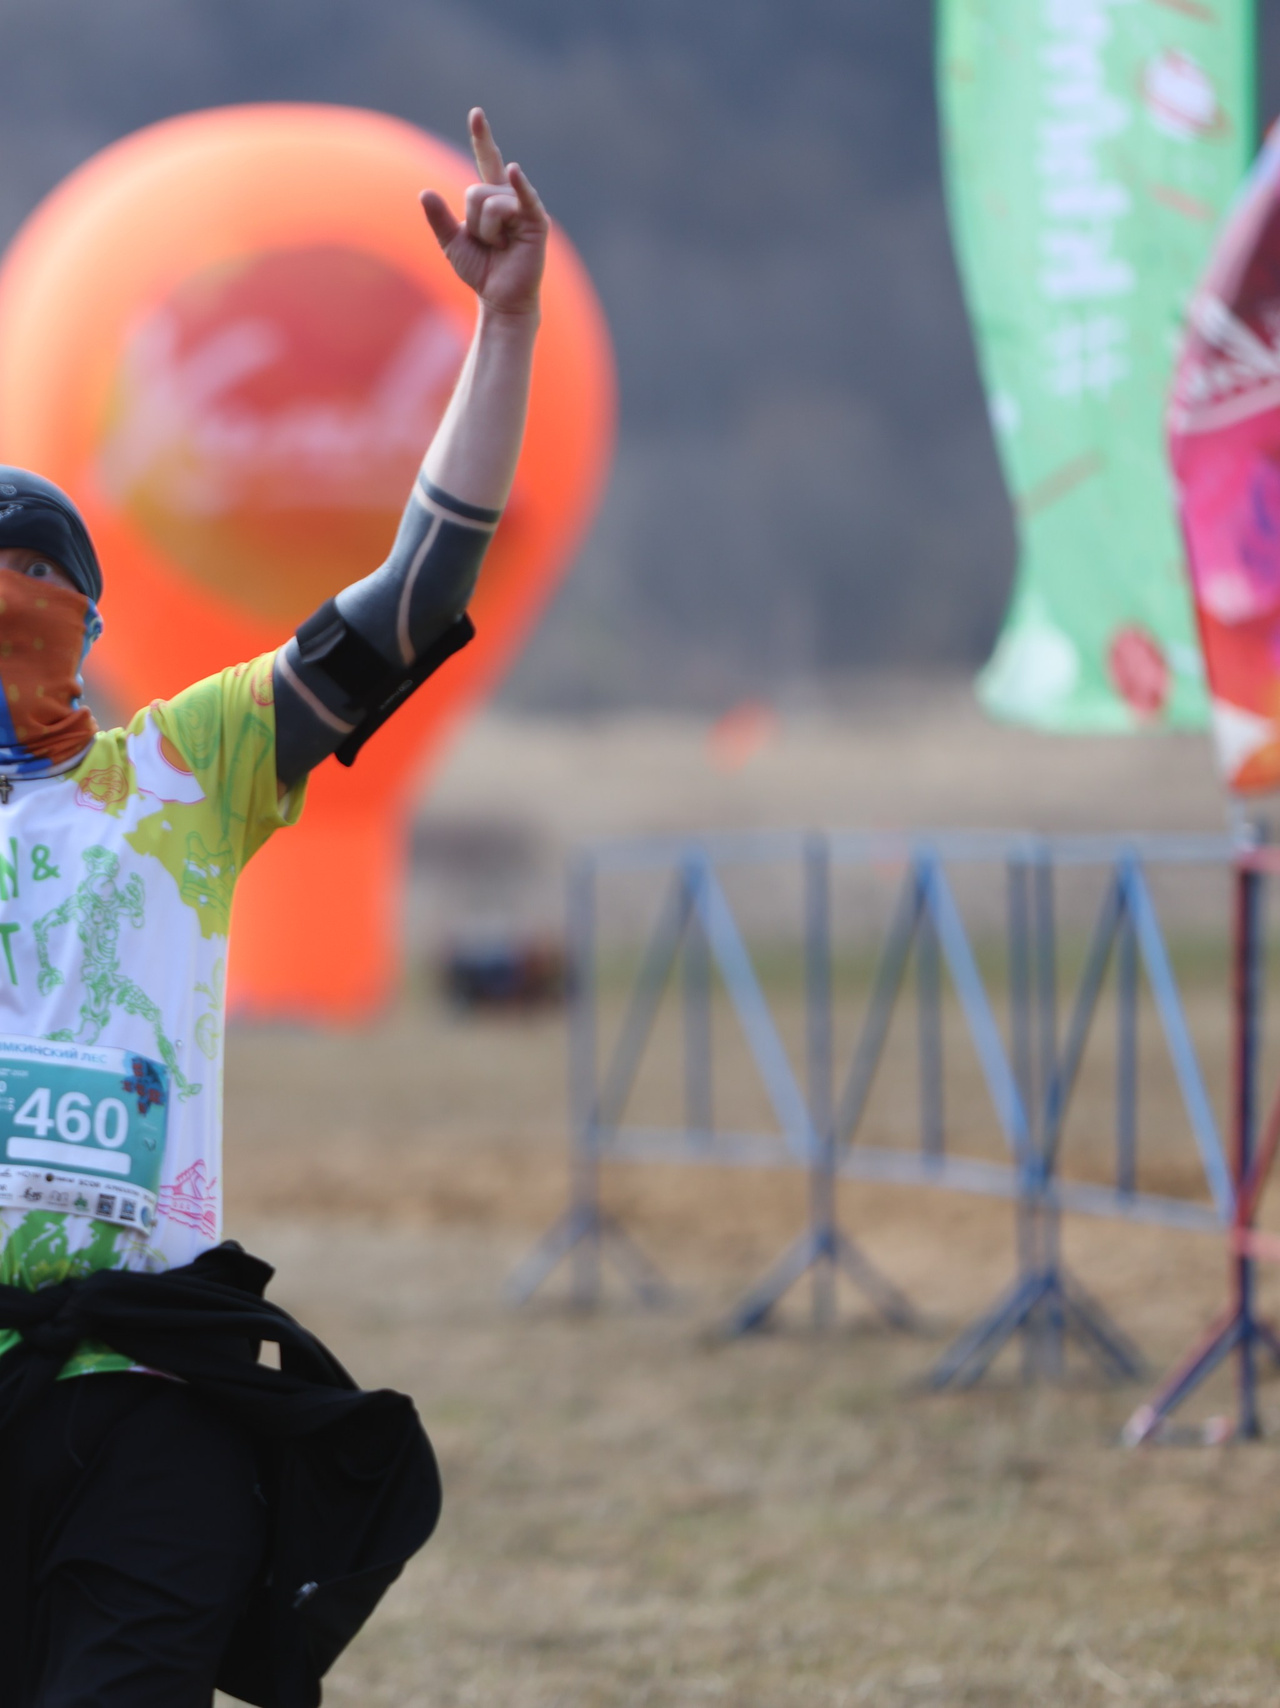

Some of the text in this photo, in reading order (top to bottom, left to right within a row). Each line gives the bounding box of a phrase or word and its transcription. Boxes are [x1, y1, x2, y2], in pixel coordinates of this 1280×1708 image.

[31, 844, 60, 881] &
[80, 1052, 108, 1064] ЛЕС
[13, 1087, 128, 1148] 460
